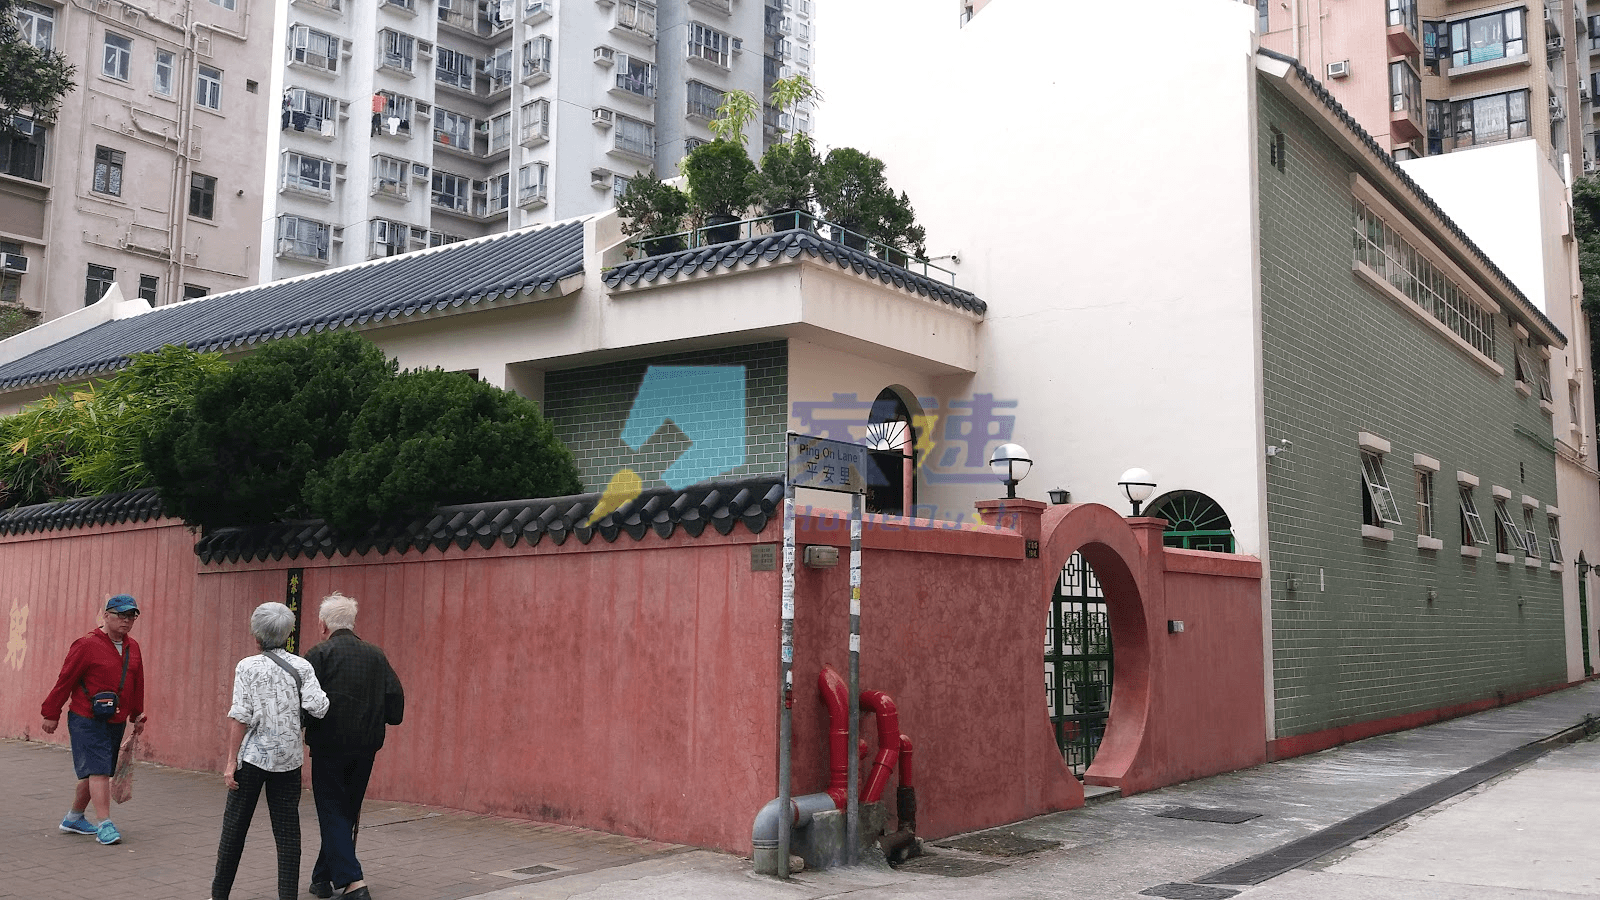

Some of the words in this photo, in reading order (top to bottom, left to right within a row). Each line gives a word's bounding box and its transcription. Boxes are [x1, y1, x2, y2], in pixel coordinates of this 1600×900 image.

[799, 443, 820, 460] Ping
[822, 447, 835, 460] On
[837, 449, 858, 463] Lane
[806, 460, 851, 486] 平安里
[285, 573, 299, 653] 禁止貼
